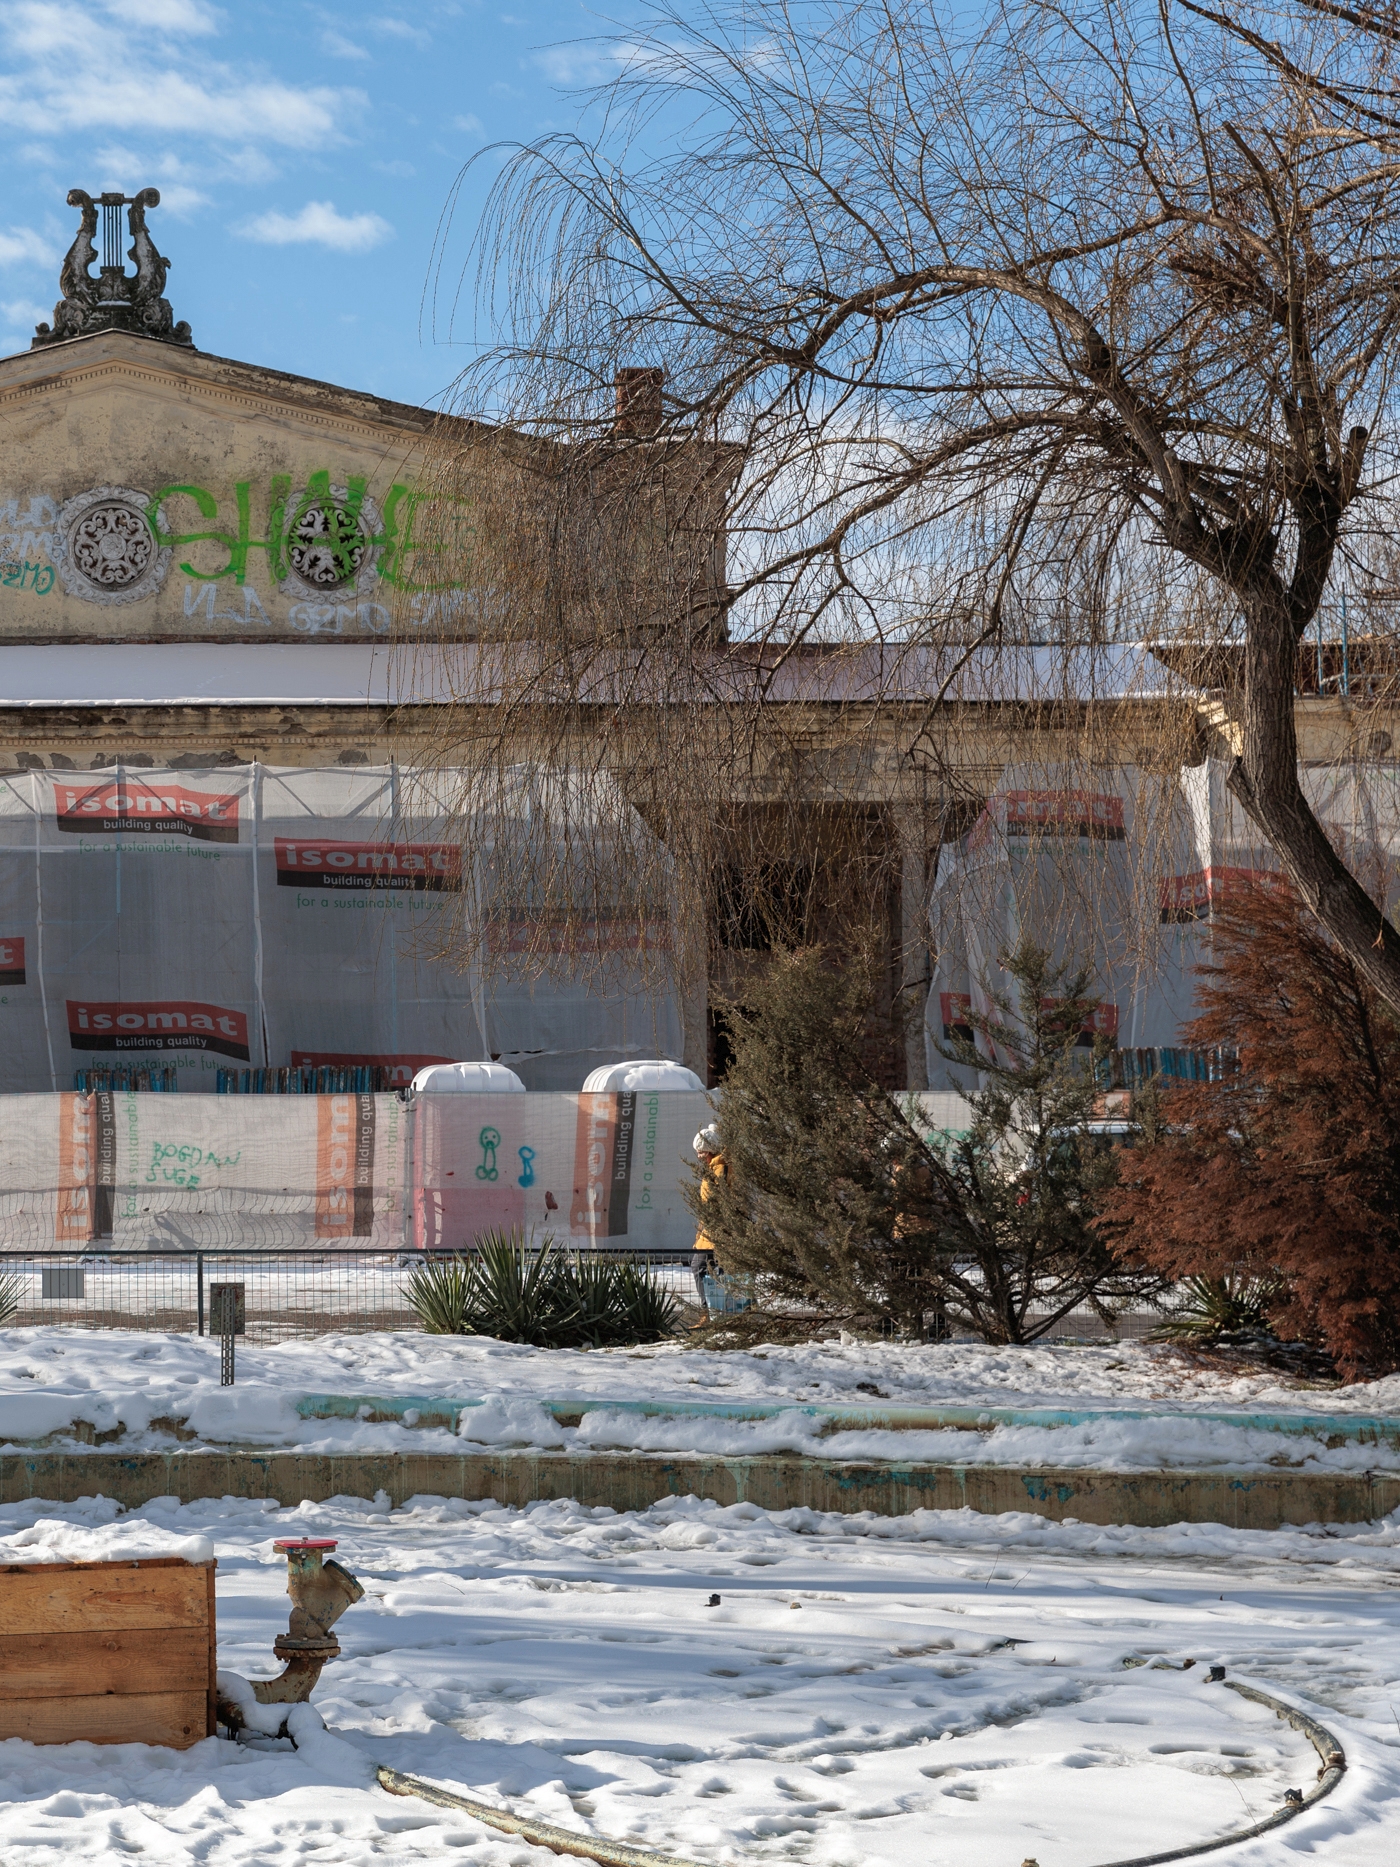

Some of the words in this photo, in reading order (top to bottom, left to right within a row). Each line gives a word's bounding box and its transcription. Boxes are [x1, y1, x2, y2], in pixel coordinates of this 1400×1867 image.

[65, 791, 227, 820] isomat
[104, 819, 150, 831] building
[155, 819, 193, 834] quality
[79, 839, 97, 854] for
[103, 843, 111, 852] a
[116, 839, 182, 853] sustainable
[187, 842, 221, 860] future
[285, 844, 448, 870] isomat
[323, 874, 372, 888] building
[377, 876, 416, 889] quality
[297, 893, 315, 909] for
[321, 899, 329, 907] a
[334, 895, 403, 910] sustainable
[77, 1008, 238, 1036] isomat
[115, 1037, 163, 1048] building
[167, 1036, 207, 1048] quality
[92, 1057, 109, 1070] for
[127, 1055, 196, 1070] sustainable
[121, 1091, 138, 1174] sustainable
[64, 1096, 90, 1227] isom
[100, 1128, 113, 1184] building
[153, 1141, 242, 1169] BOGDAN
[323, 1095, 349, 1225] isom
[358, 1126, 372, 1184] building
[615, 1122, 631, 1180] building
[129, 1180, 138, 1189] a
[146, 1161, 200, 1191] SUGE
[386, 1177, 396, 1187] a
[643, 1172, 653, 1182] a
[121, 1199, 138, 1218] for
[635, 1185, 653, 1210] for
